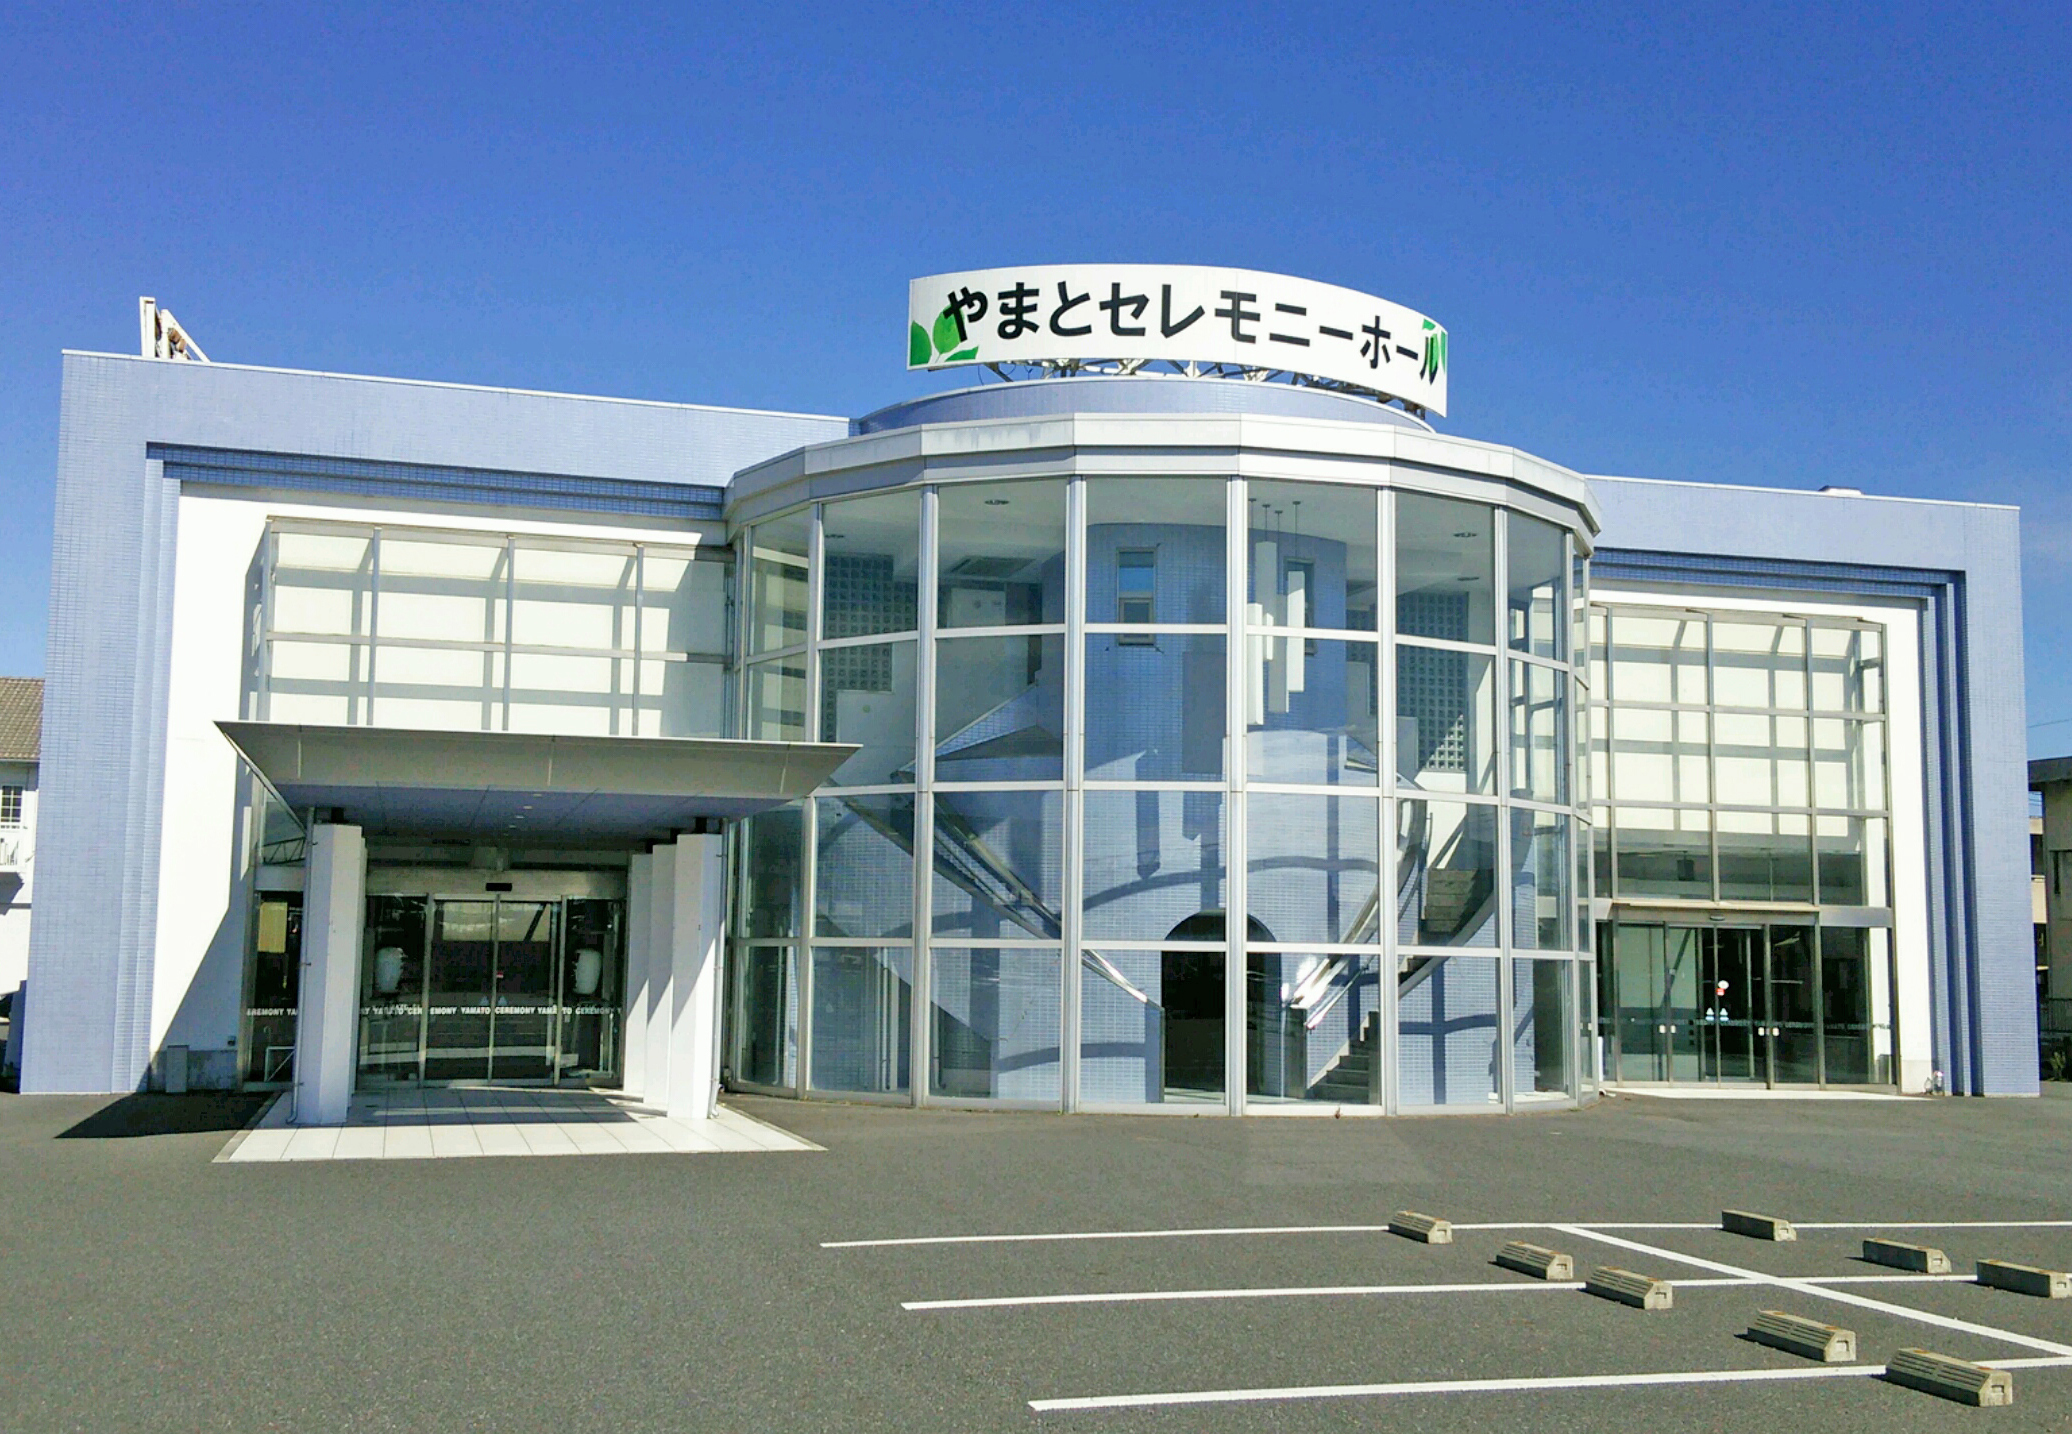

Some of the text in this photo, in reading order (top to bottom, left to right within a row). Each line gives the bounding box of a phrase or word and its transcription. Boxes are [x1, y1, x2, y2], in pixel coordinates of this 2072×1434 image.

[943, 280, 1439, 386] やまとセレモニーホール
[495, 1006, 536, 1015] CEREMONY
